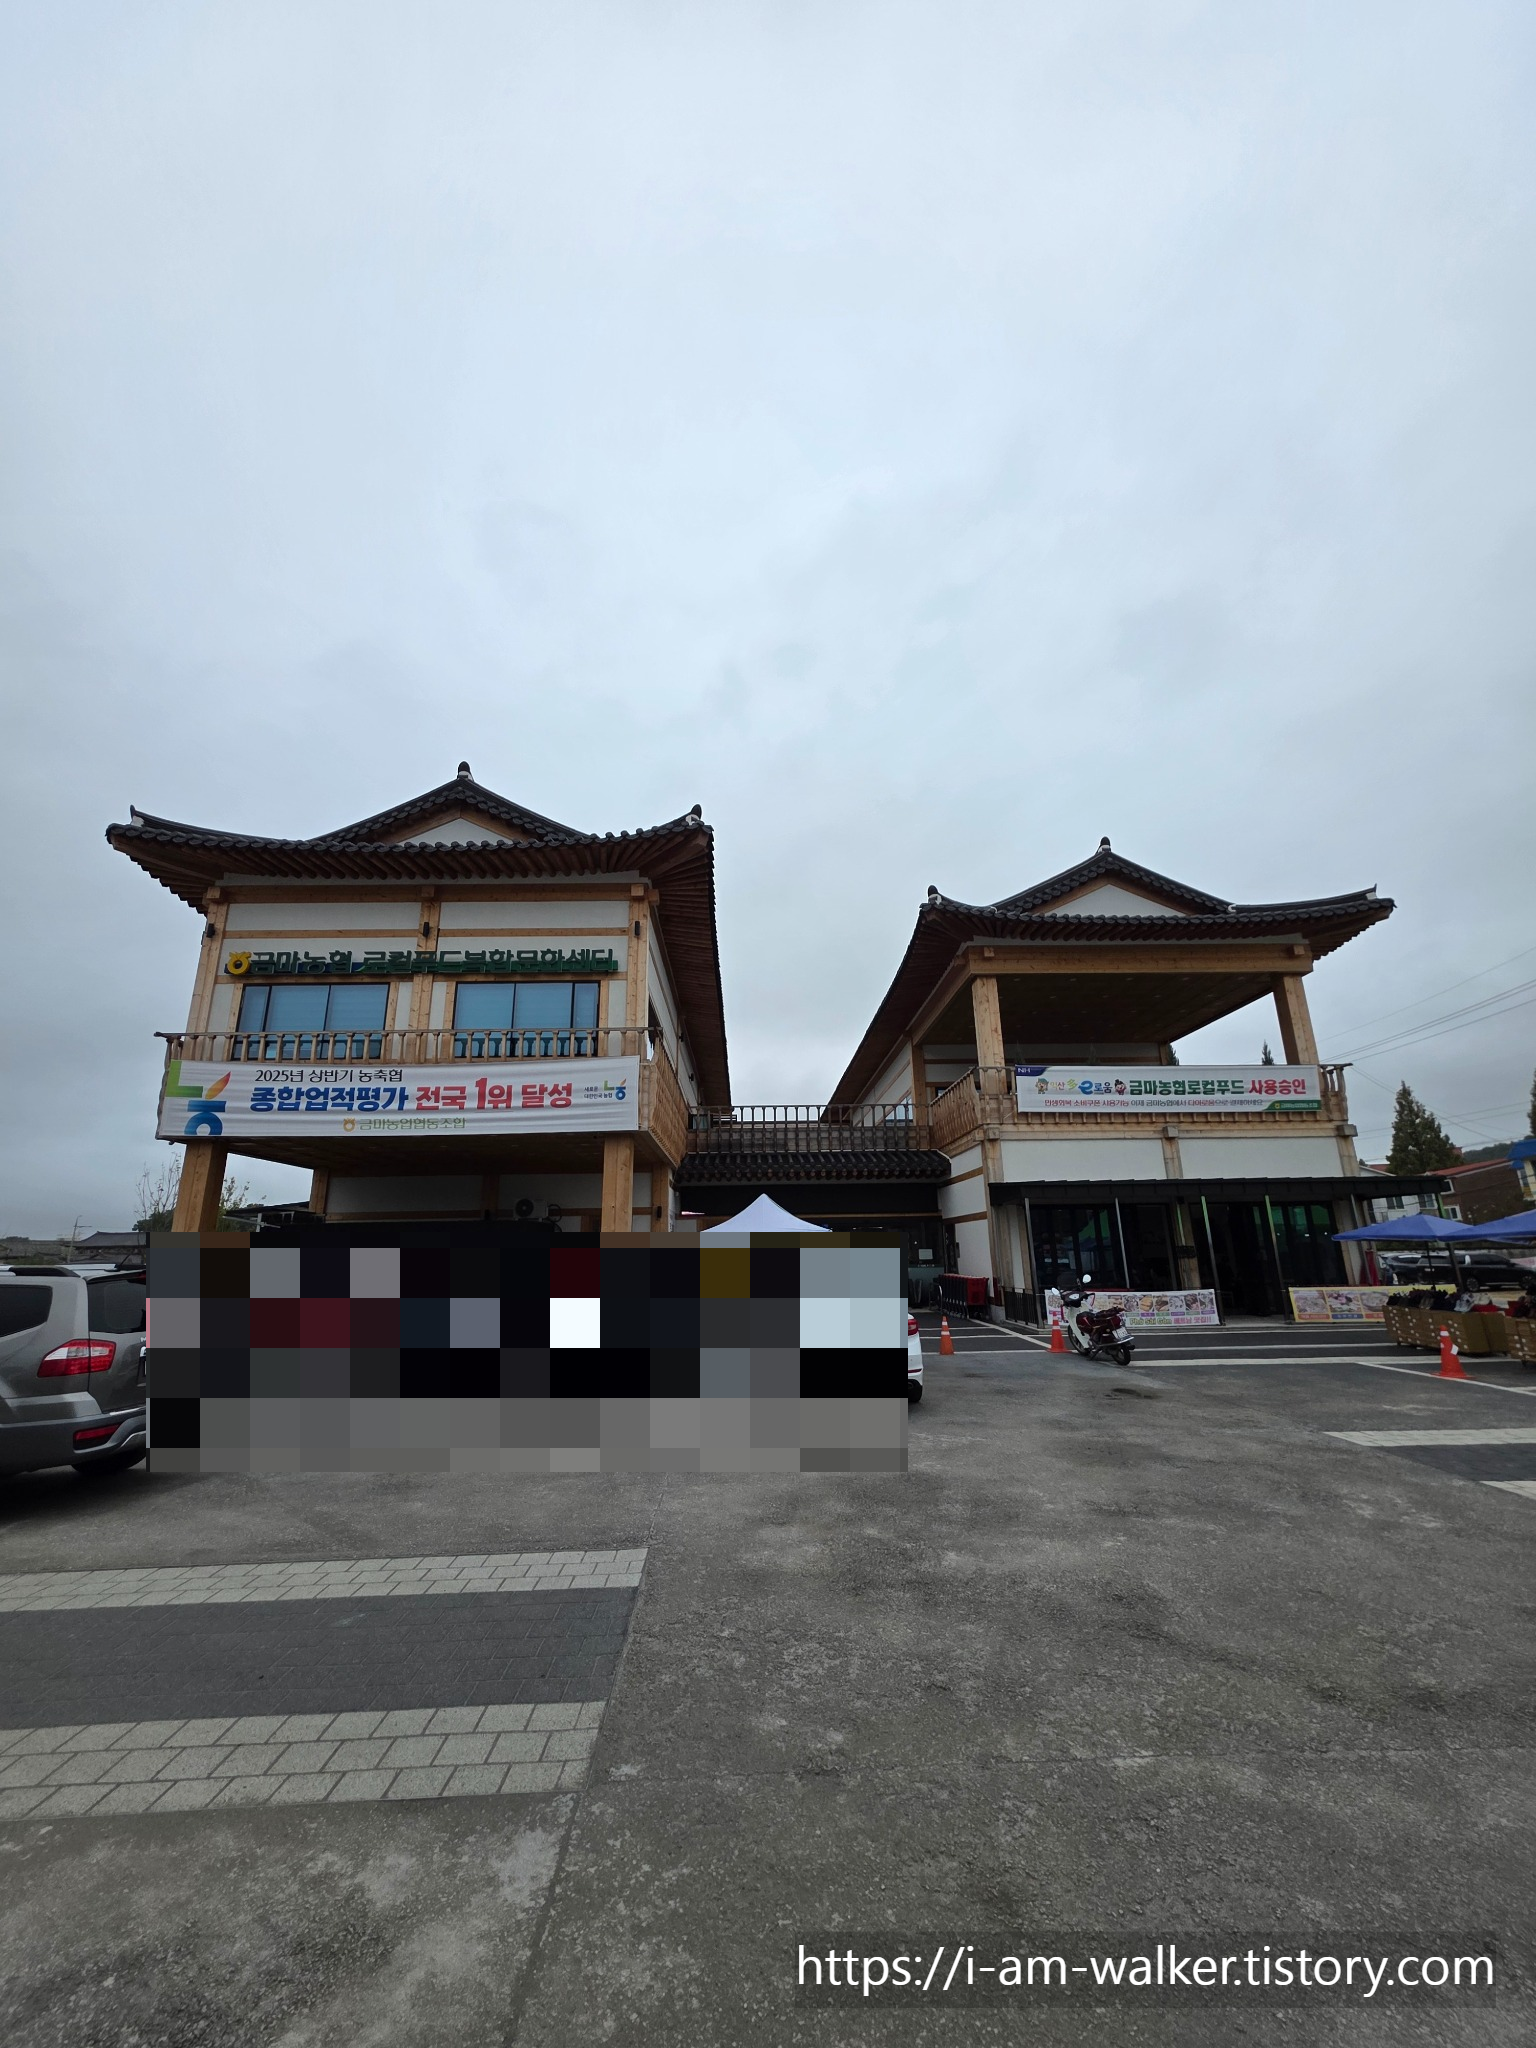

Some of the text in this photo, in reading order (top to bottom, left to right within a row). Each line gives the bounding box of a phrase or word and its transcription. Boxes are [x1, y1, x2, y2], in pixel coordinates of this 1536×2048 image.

[251, 951, 353, 974] 금마농협
[255, 1069, 403, 1083] 2025년 상반기 농축협
[250, 1077, 573, 1112] 종합업적평가 전국 1위 달성
[1130, 1080, 1244, 1095] 금마농협로컬푸드
[1249, 1079, 1306, 1095] 사용승인
[359, 1117, 466, 1130] 금마농업협동조합
